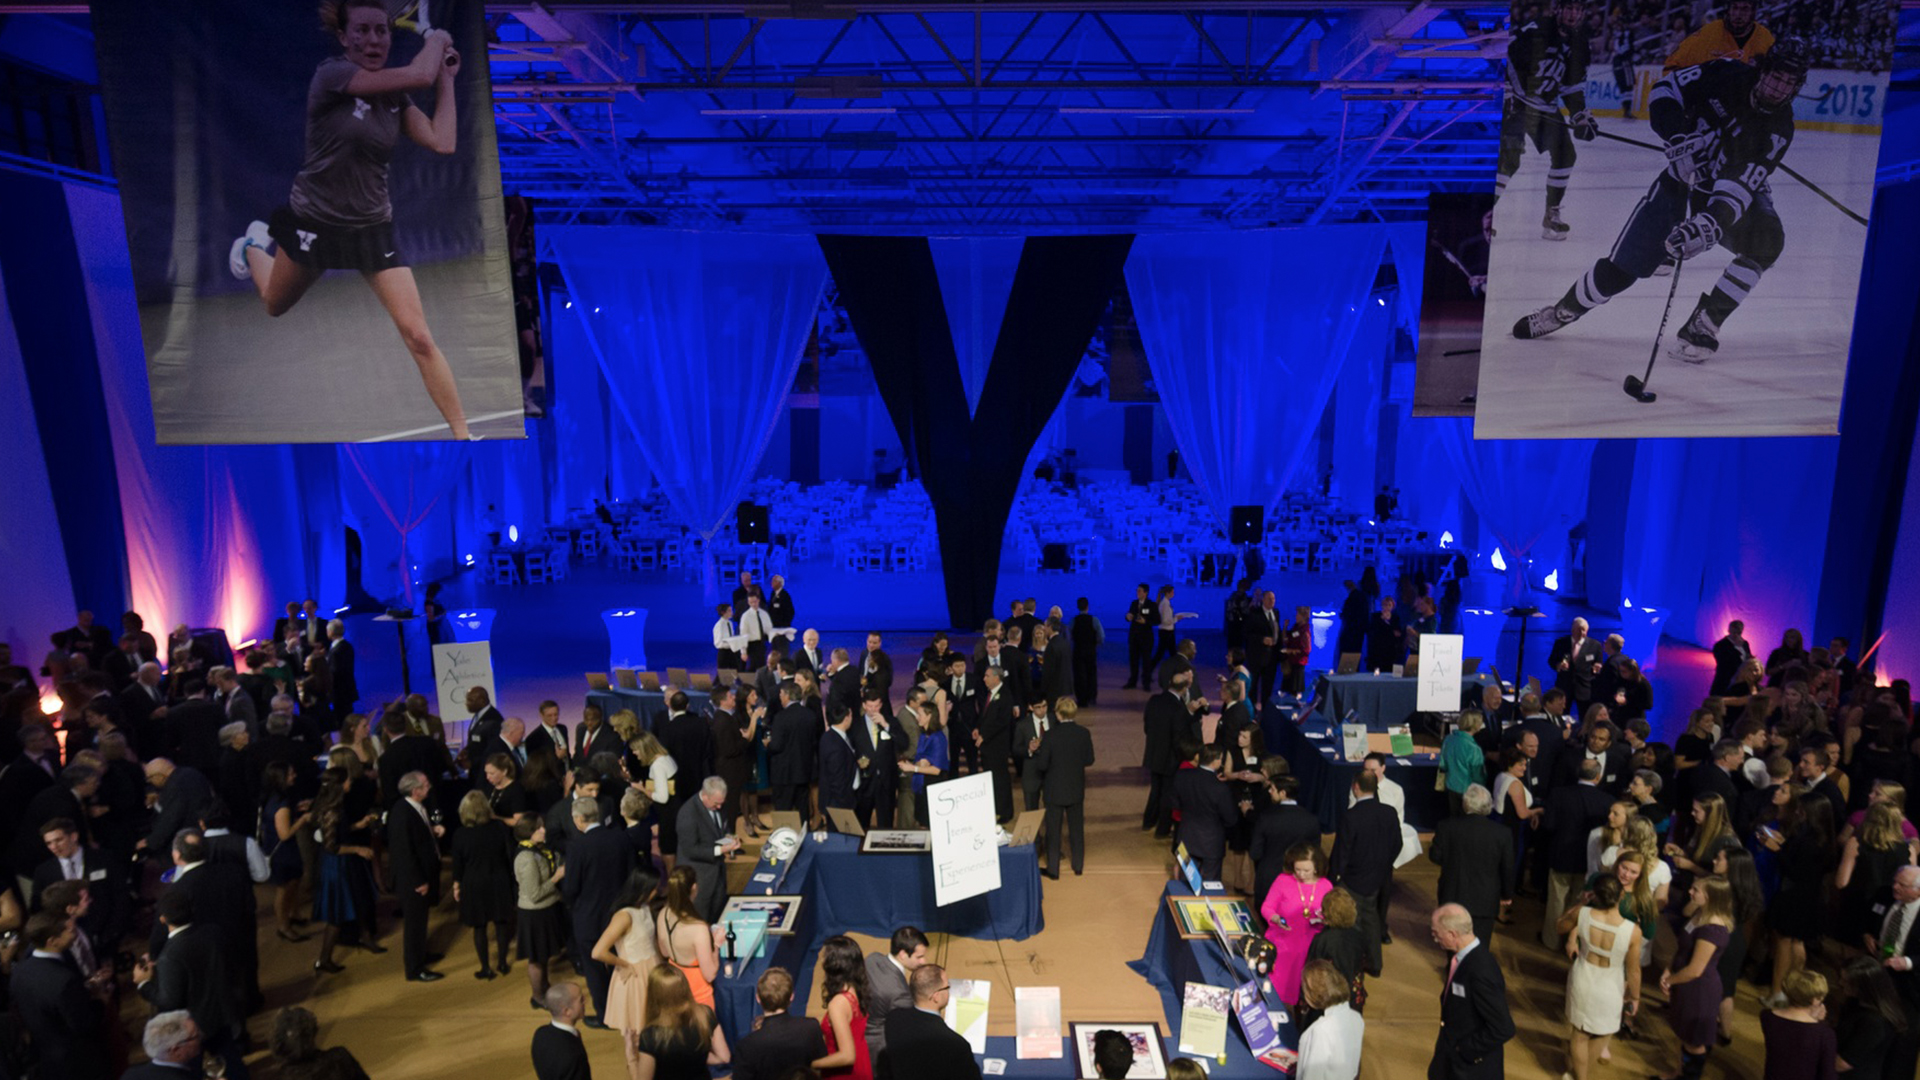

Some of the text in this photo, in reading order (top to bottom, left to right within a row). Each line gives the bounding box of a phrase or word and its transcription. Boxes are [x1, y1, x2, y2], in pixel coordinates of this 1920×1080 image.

[1815, 83, 1876, 118] 2013
[1740, 162, 1767, 191] 18
[446, 650, 471, 667] Yale
[935, 782, 987, 816] Special
[946, 820, 973, 845] Items
[973, 833, 986, 851] &
[938, 859, 996, 888] Experiences
